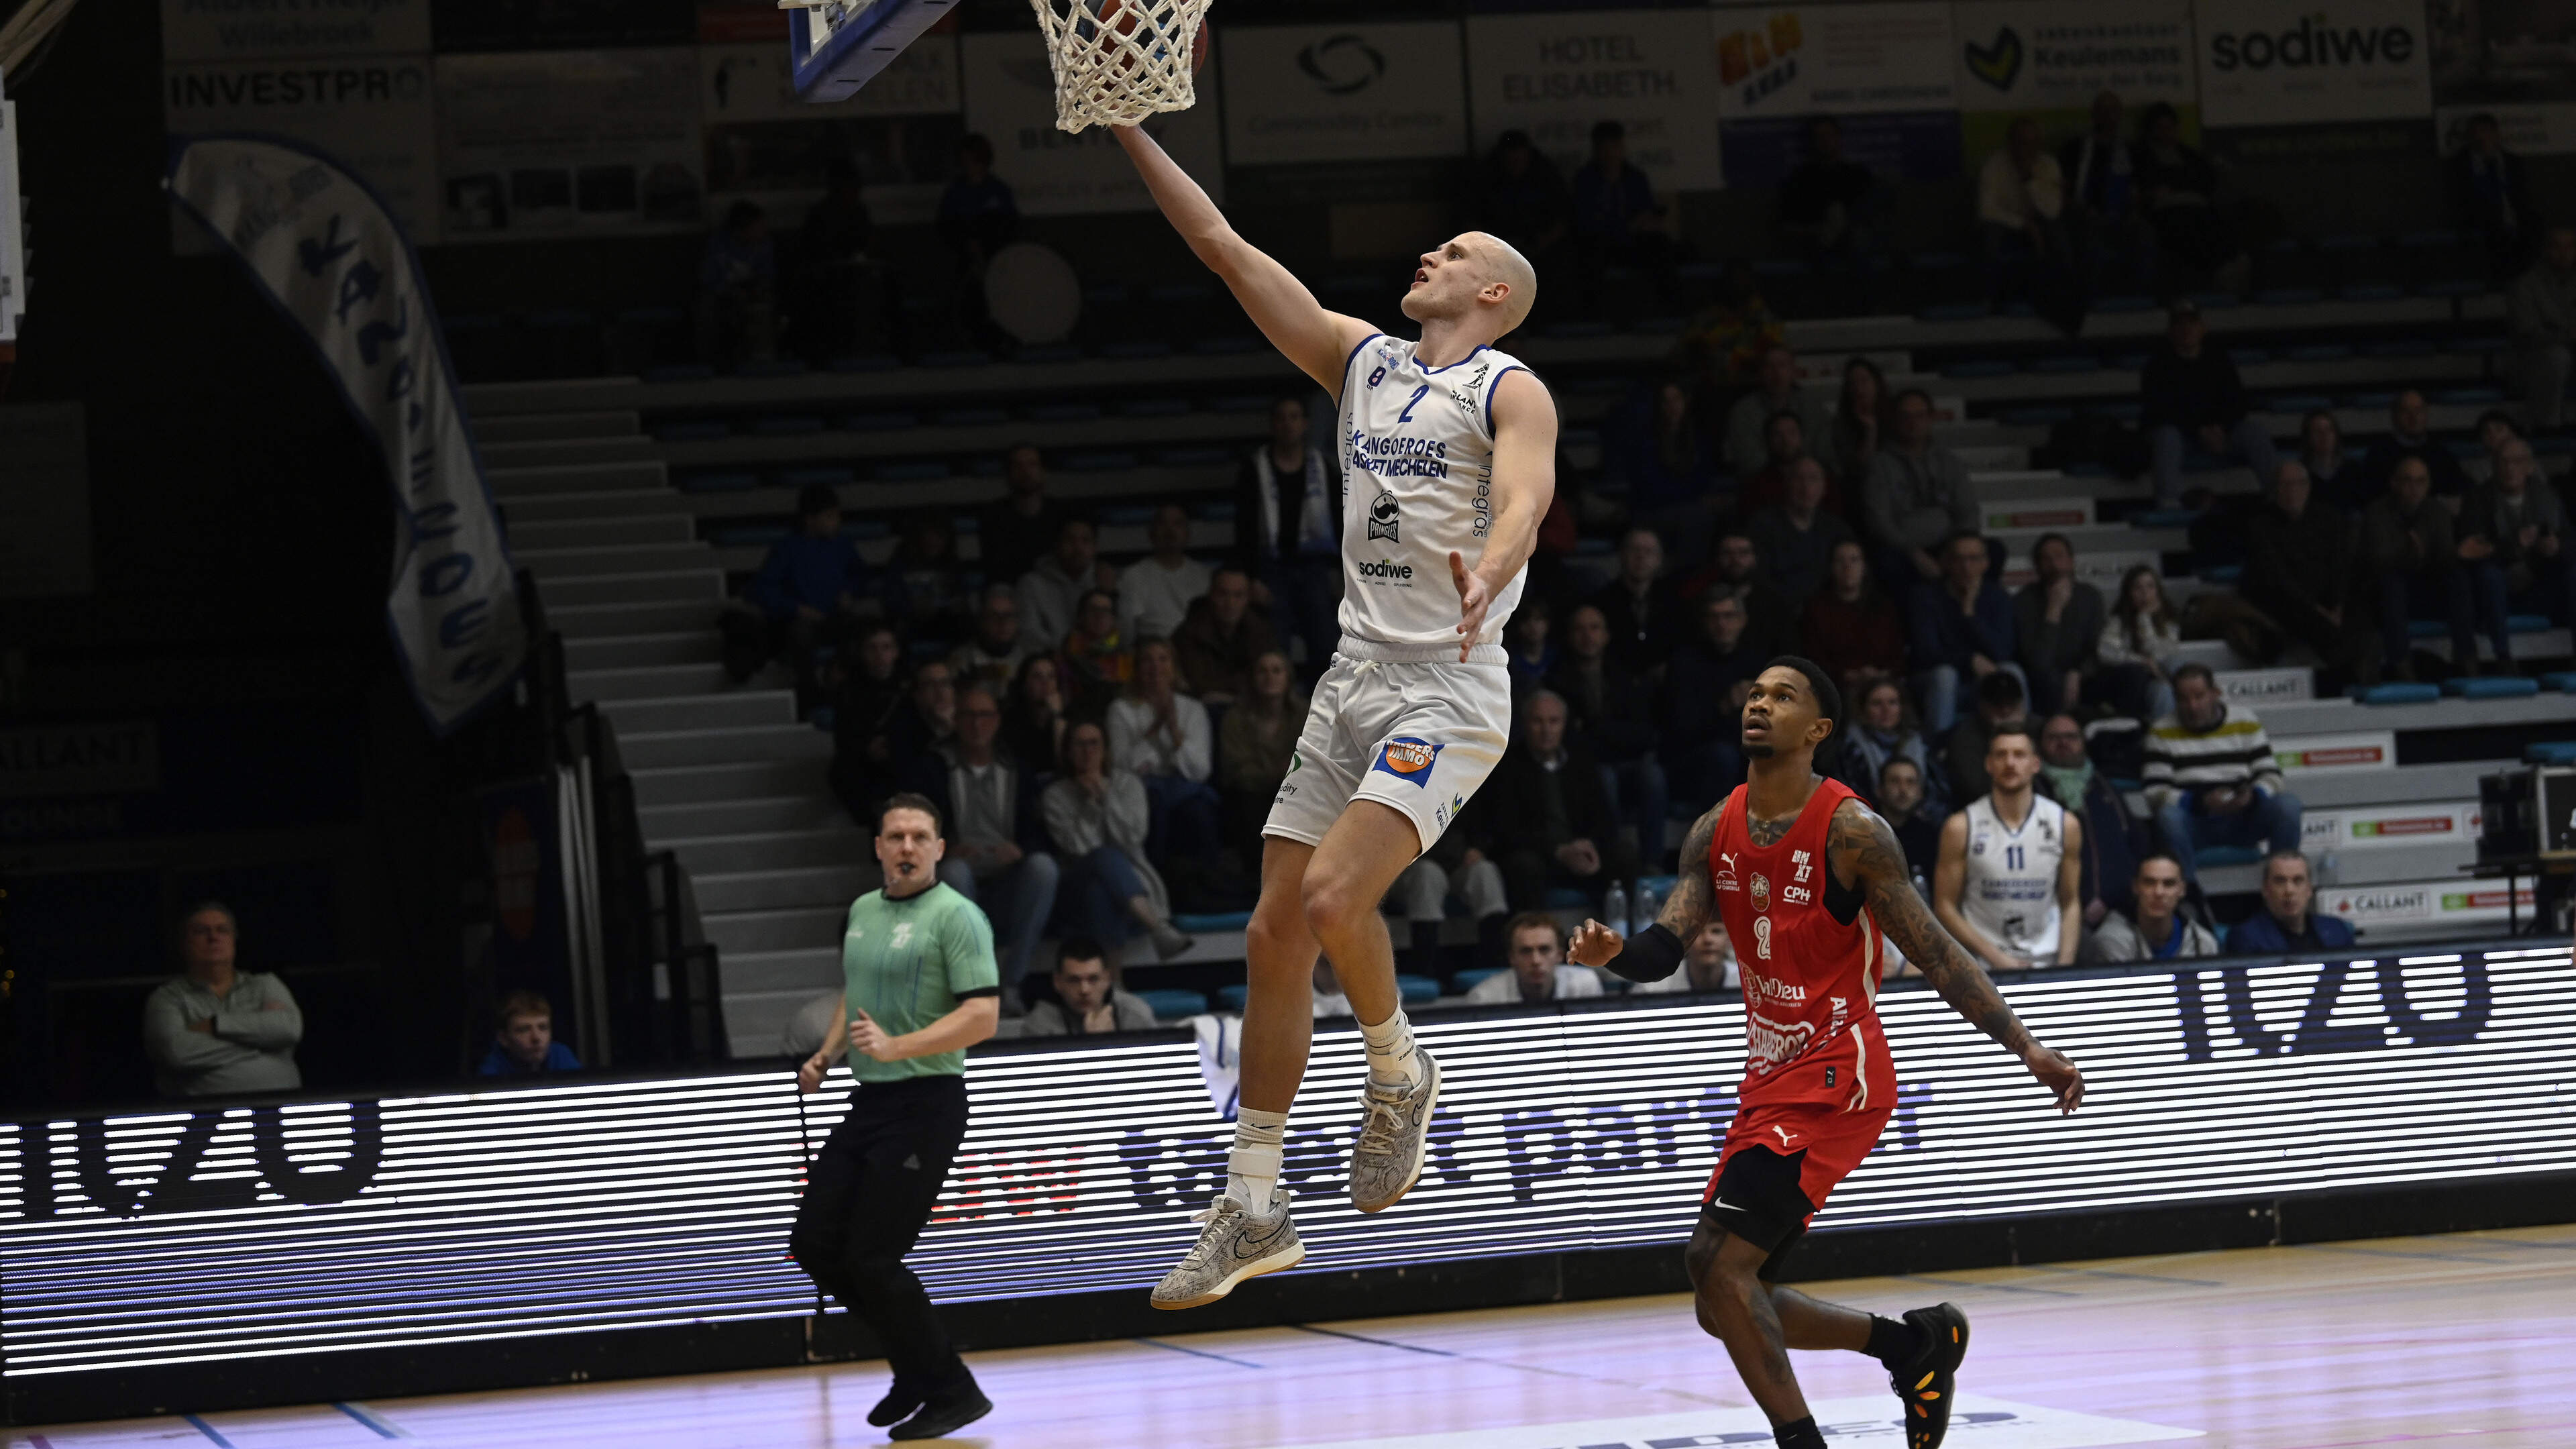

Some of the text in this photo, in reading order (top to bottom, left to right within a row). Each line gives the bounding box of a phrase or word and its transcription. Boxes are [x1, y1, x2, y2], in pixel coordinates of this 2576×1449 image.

[1538, 35, 1644, 63] HOTEL
[2211, 13, 2414, 70] sodiwe
[171, 66, 423, 107] INVESTPRO
[1502, 70, 1676, 103] ELISABETH
[1397, 384, 1430, 424] 2
[1352, 429, 1446, 459] KANGOEROES
[1352, 450, 1448, 479] ASKET MECHELEN
[1369, 521, 1397, 541] PRINGLES
[1358, 558, 1413, 580] sodiwe
[2226, 680, 2297, 697] CALLANT
[1388, 747, 1425, 765] IMMO
[2006, 846, 2025, 870] 11
[1784, 885, 1811, 902] CPH
[2355, 894, 2425, 912] CALLANT
[1754, 916, 1772, 960] 2
[1504, 1082, 1933, 1203] partr
